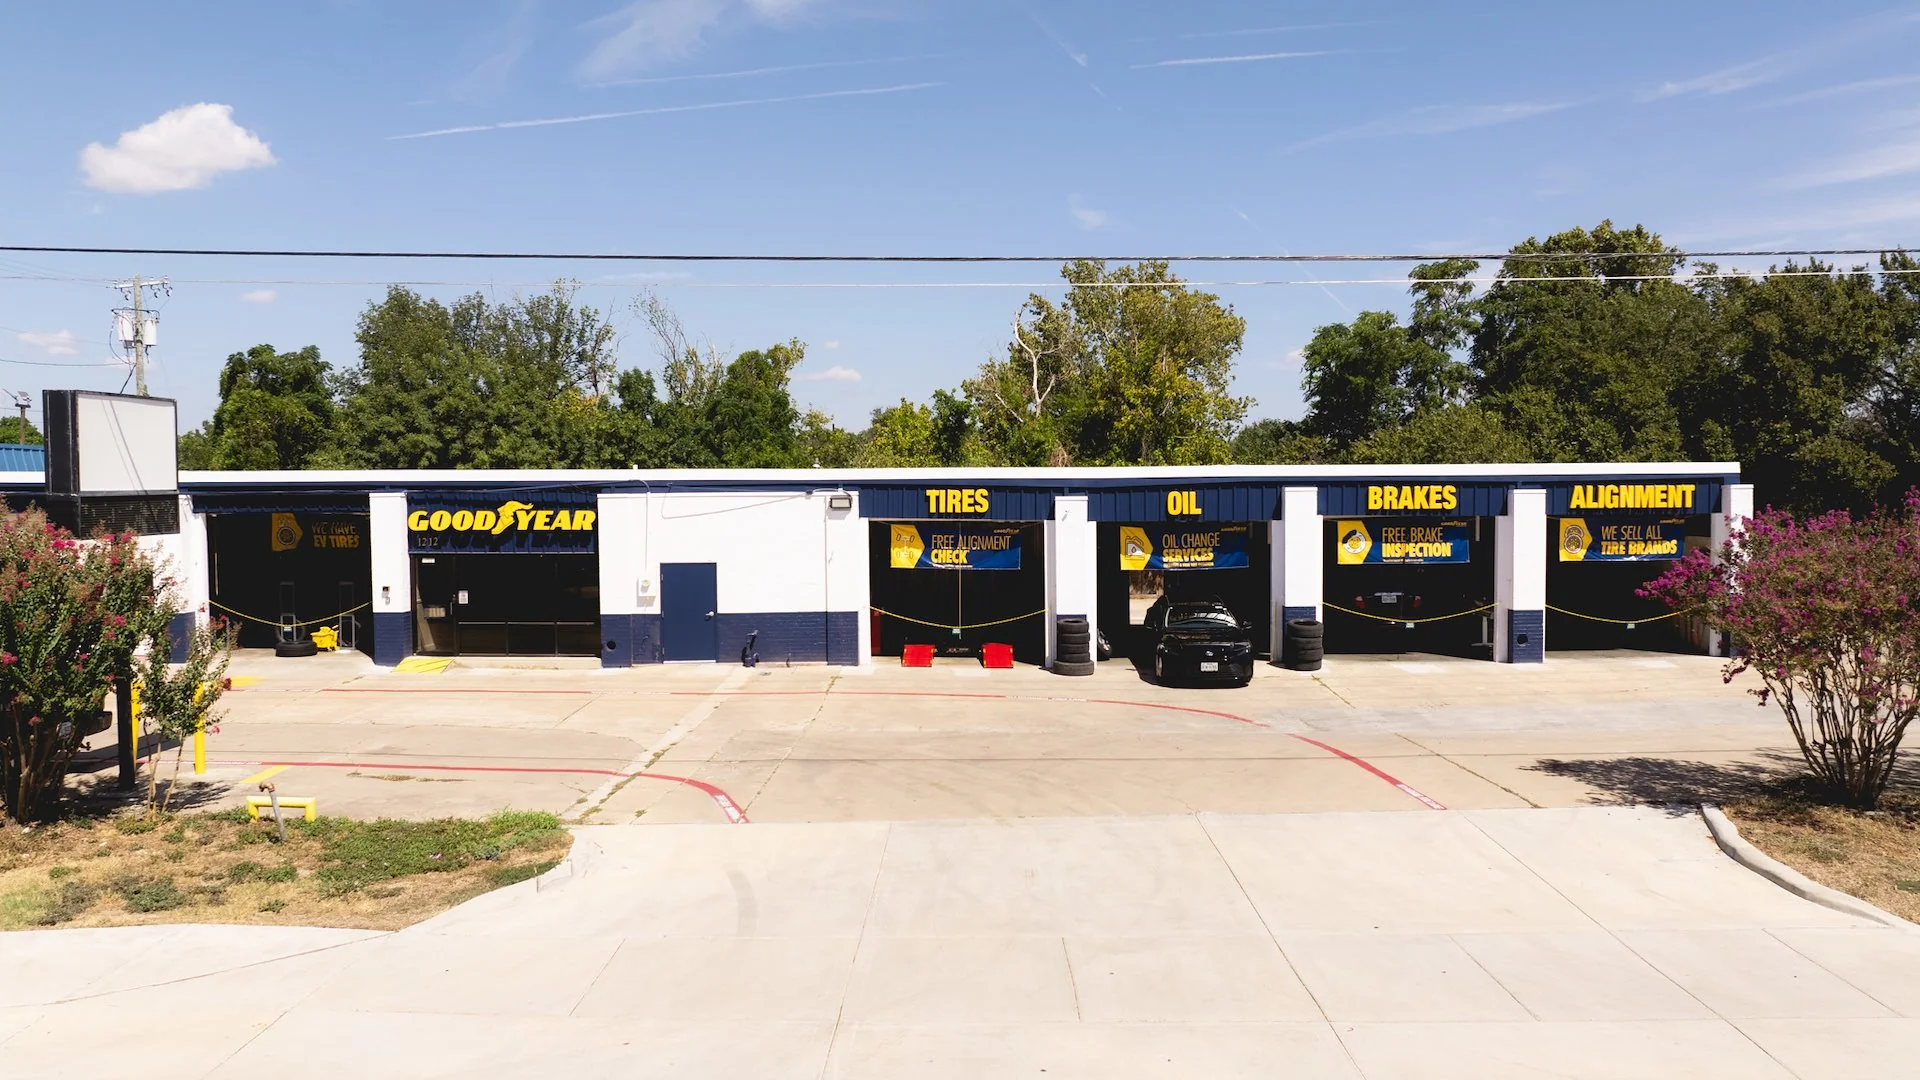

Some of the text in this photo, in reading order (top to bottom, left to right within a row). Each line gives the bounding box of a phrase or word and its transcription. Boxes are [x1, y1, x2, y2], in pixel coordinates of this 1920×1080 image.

[925, 488, 989, 513] TIRES
[1167, 490, 1202, 515] OIL
[1368, 485, 1457, 510] BRAKES
[1569, 484, 1696, 509] ALIGNMENT
[312, 521, 356, 534] WE HAVE
[1382, 527, 1443, 543] FREE BRAKE
[1601, 525, 1662, 540] WE SELL ALL
[314, 534, 360, 548] EV TIRES
[418, 537, 438, 546] 1212
[931, 534, 1011, 550] FREE ALIGNMENT
[1162, 532, 1220, 549] OIL CHANGE
[1601, 540, 1678, 555] TIRE BRANDS
[931, 549, 968, 564] CHECK
[1162, 547, 1214, 563] SERVICES
